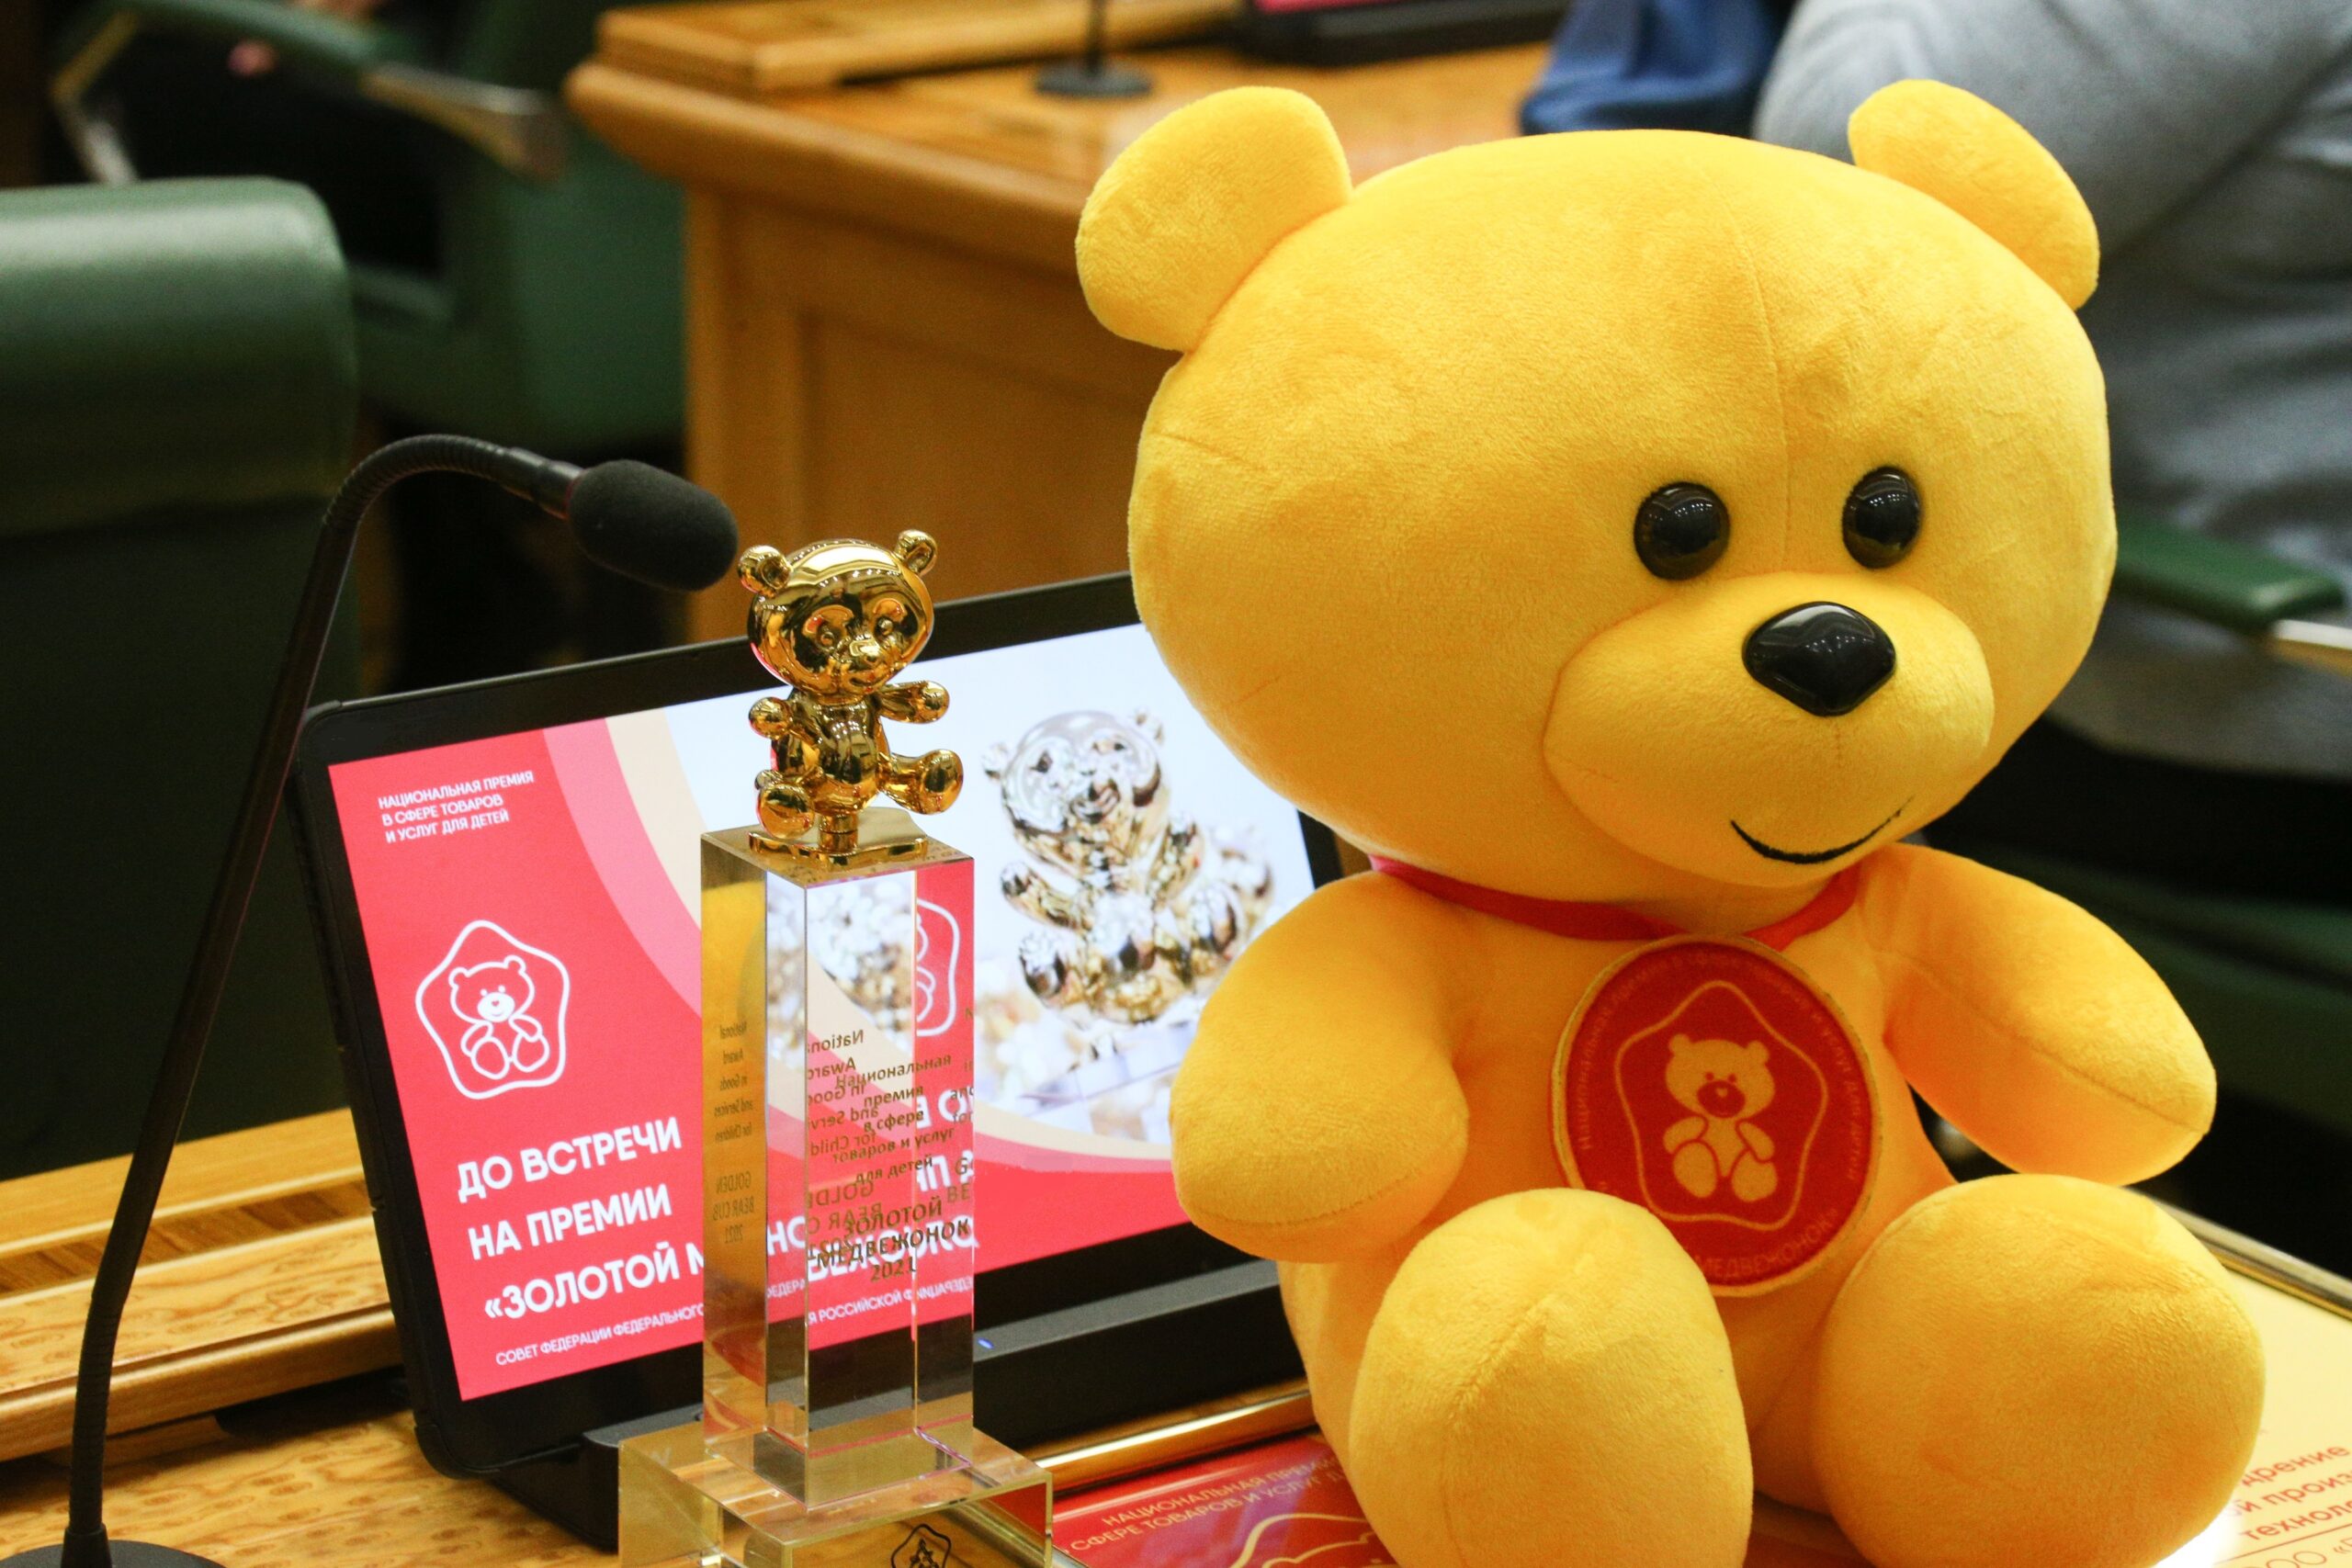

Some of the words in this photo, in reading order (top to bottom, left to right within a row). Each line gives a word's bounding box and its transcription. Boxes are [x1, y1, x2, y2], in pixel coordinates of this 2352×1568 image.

[379, 780, 481, 809] НАЦИОНАЛЬНАЯ
[483, 770, 535, 790] ПРЕМИЯ
[381, 814, 392, 827] В
[394, 804, 438, 825] СФЕРЕ
[440, 794, 503, 816] ТОВАРОВ
[385, 830, 396, 843] И
[398, 822, 437, 840] УСЛУГ
[441, 818, 469, 835] ДЛЯ
[470, 808, 510, 829] ДЕТЕЙ
[836, 1055, 951, 1089] Национальная
[865, 1086, 923, 1108] премия
[876, 1110, 924, 1130] сфере
[458, 1156, 514, 1203] ДО
[520, 1116, 682, 1182] ВСТРЕЧИ
[832, 1142, 895, 1164] товаров
[914, 1128, 955, 1148] услуг
[855, 1168, 883, 1187] для
[888, 1155, 933, 1179] детей
[468, 1220, 522, 1260] НА
[526, 1183, 673, 1247] ПРЕМИИ
[844, 1195, 942, 1237] ЗОЛОТОЙ
[816, 1219, 969, 1268] МЕДВЕЖОНОК
[484, 1241, 680, 1319] «ЗОЛОТОЙ
[871, 1256, 917, 1282] 2021
[496, 1344, 538, 1367] СОВЕТ
[540, 1325, 612, 1355] ФЕДЕРАЦИИ
[1070, 1524, 1143, 1551] СФЕРЕ
[1140, 1496, 1242, 1529] ТОВАРОВ
[1242, 1492, 1261, 1504] И
[1260, 1477, 1320, 1499] УСЛУГ
[1102, 1475, 1265, 1527] НАЦИОНАЛЬНАЯ
